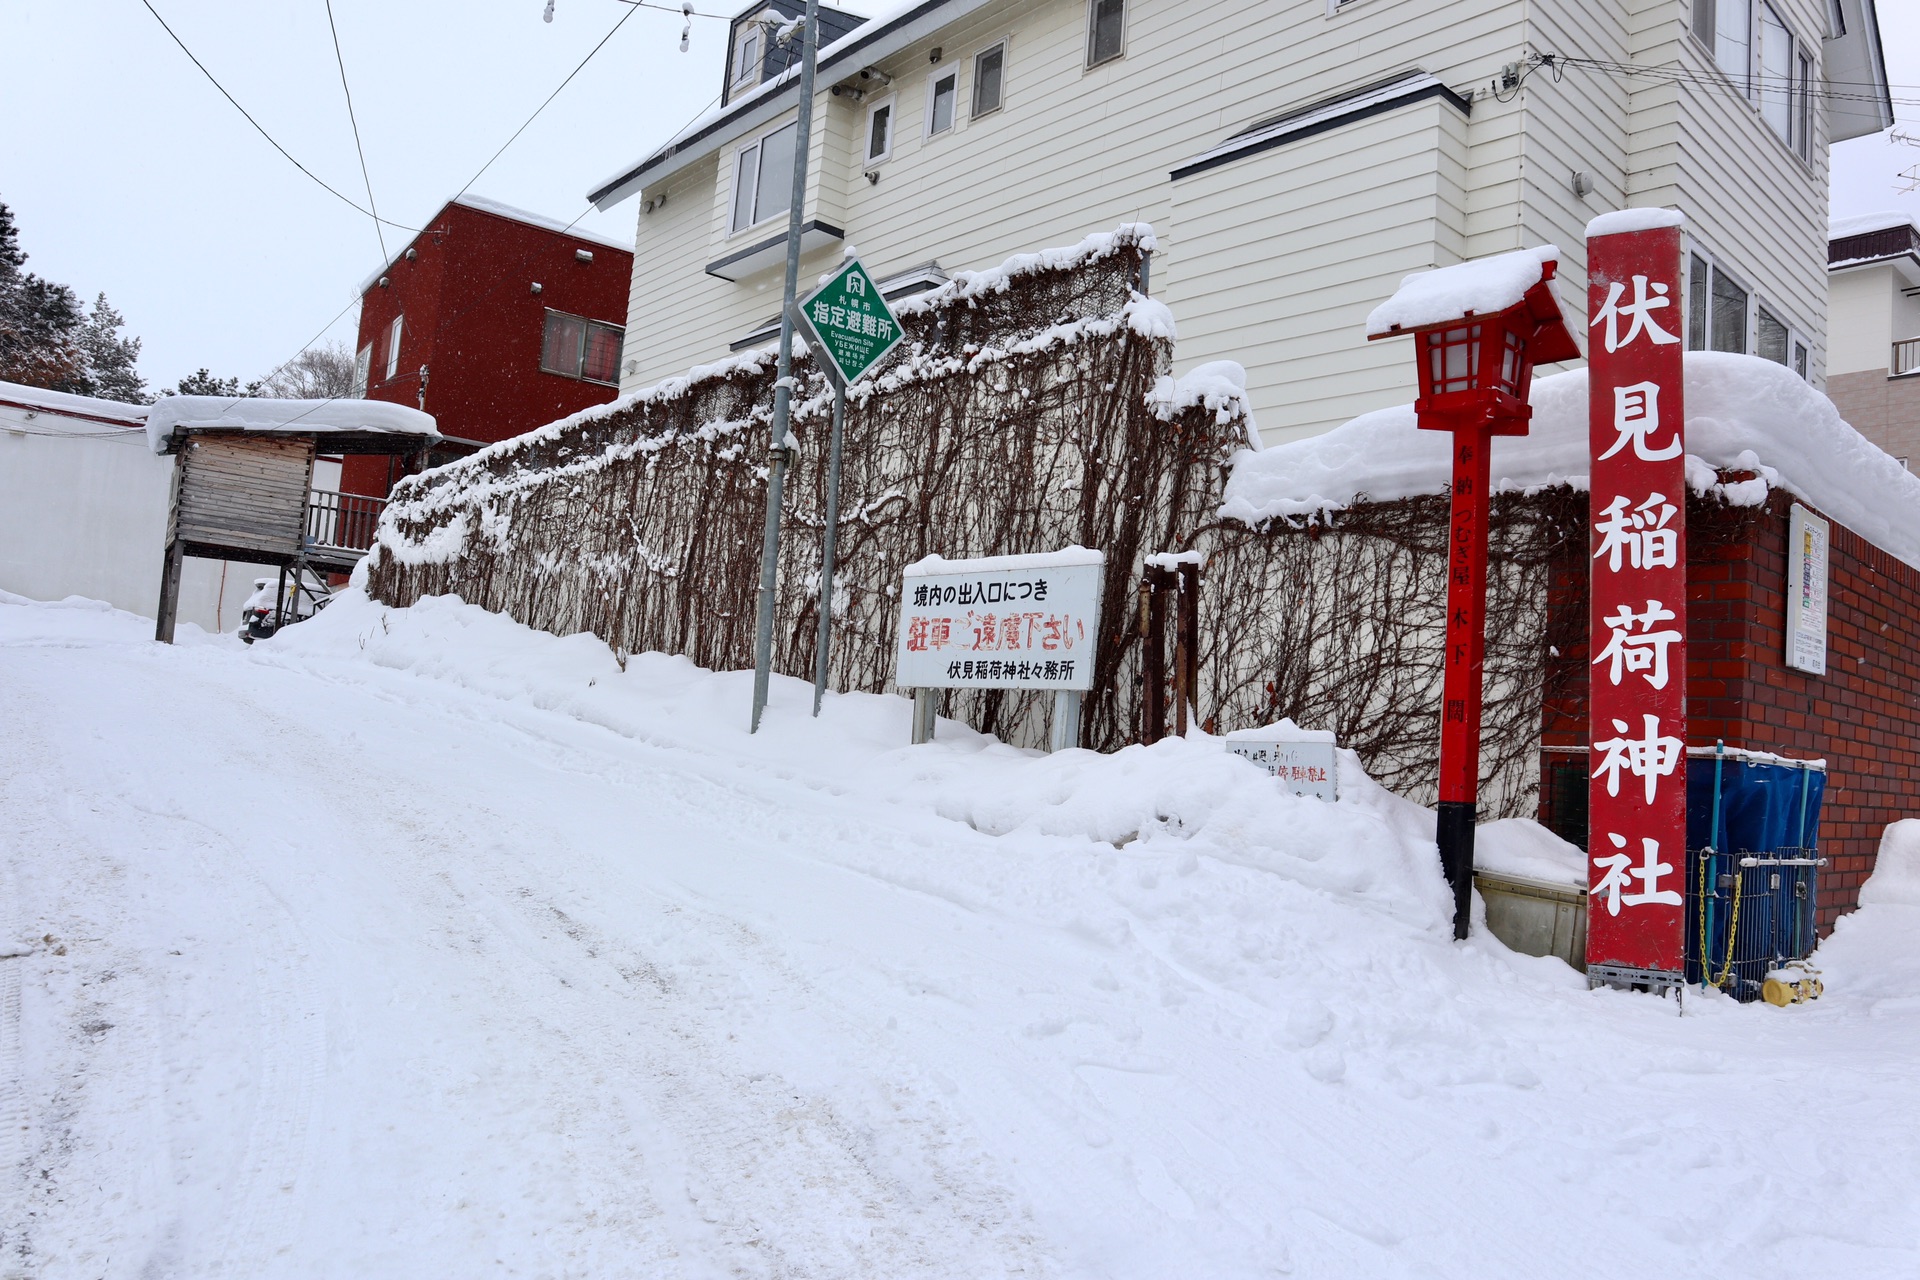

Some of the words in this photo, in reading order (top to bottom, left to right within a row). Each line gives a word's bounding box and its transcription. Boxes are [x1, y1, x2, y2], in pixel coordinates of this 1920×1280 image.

[813, 300, 892, 341] 指定避難所
[839, 295, 871, 312] 札幌市
[830, 330, 862, 345] Evacuation
[862, 338, 874, 348] Site
[834, 339, 869, 355] УБЕЖИЩЕ
[838, 357, 864, 369] 피난장소
[1456, 445, 1473, 495] 奉納
[1452, 509, 1472, 586] つむぎ屋
[913, 578, 1048, 607] 境内の出入口につき
[1590, 275, 1683, 916] 伏見稲荷神社
[906, 610, 1085, 652] 駐車ご遠慮下さい
[1450, 607, 1469, 665] 木下
[947, 660, 1075, 681] 伏見稲荷神社々務所
